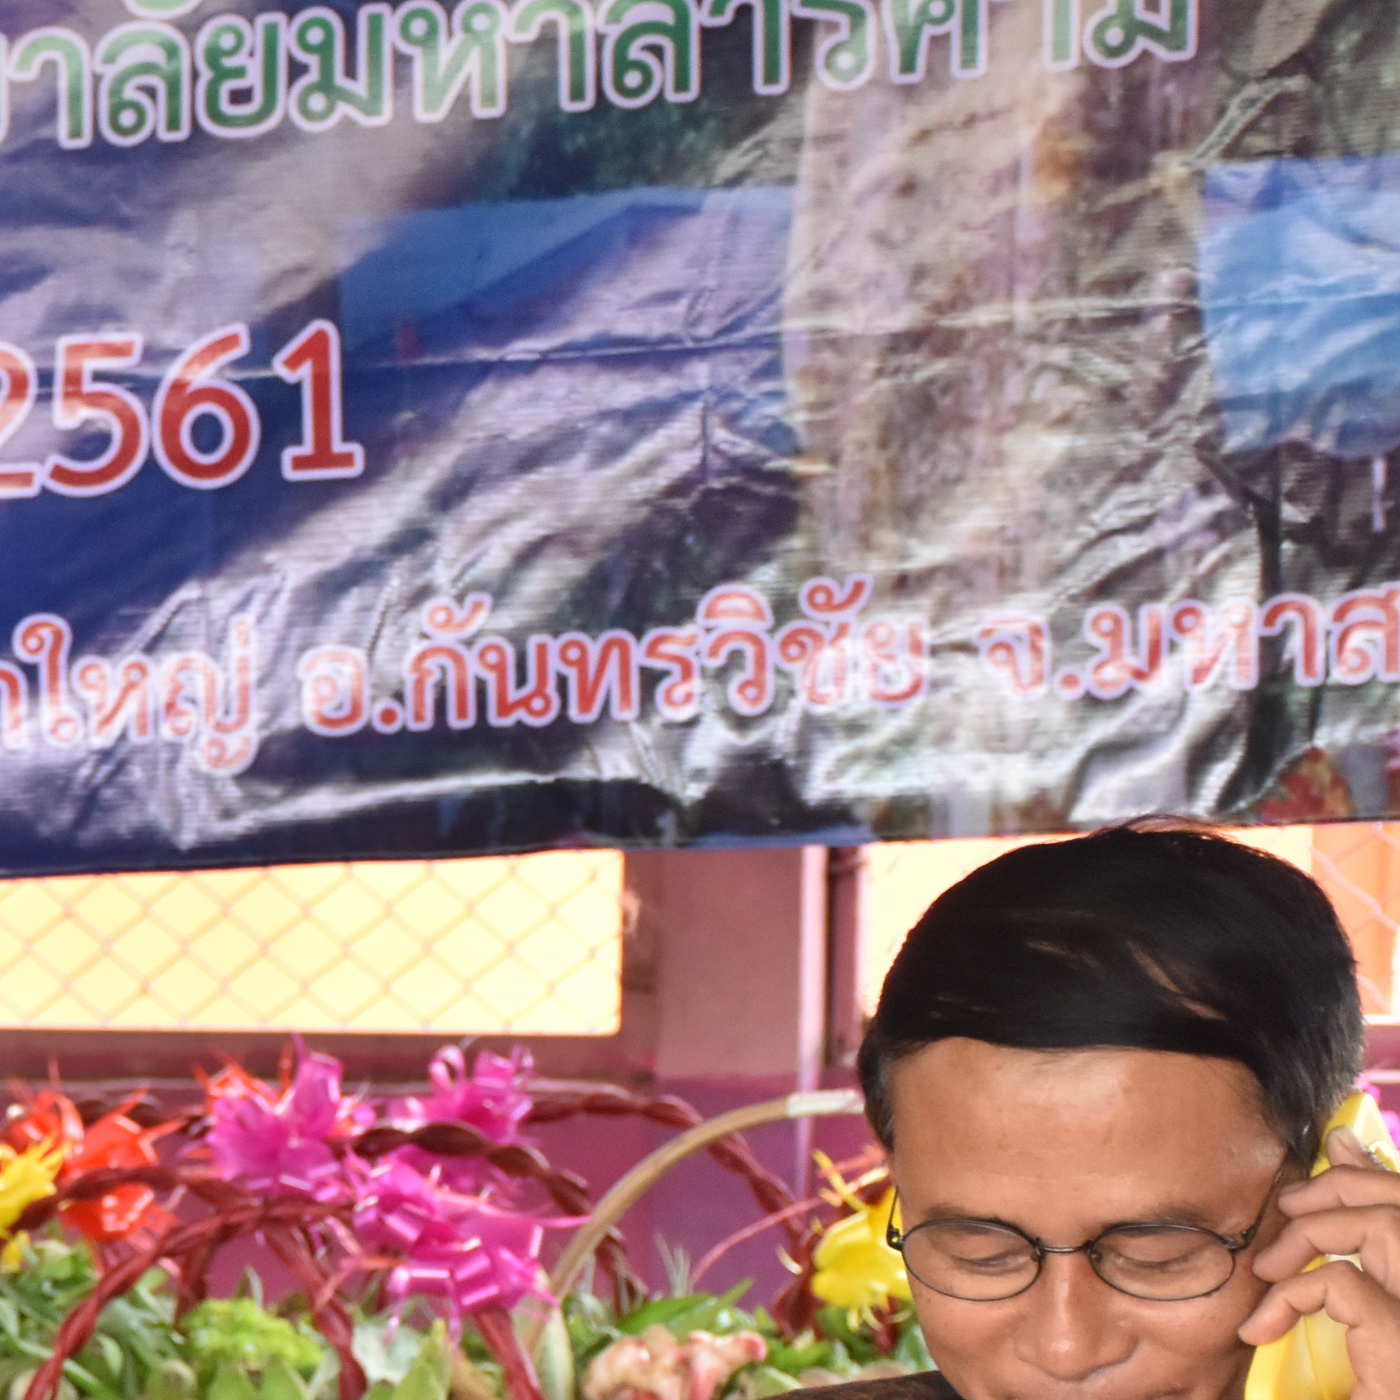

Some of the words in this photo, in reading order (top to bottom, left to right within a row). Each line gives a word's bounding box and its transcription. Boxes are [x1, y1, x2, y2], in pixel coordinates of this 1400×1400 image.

[299, 574, 926, 737] อ.กันทรวิชัย
